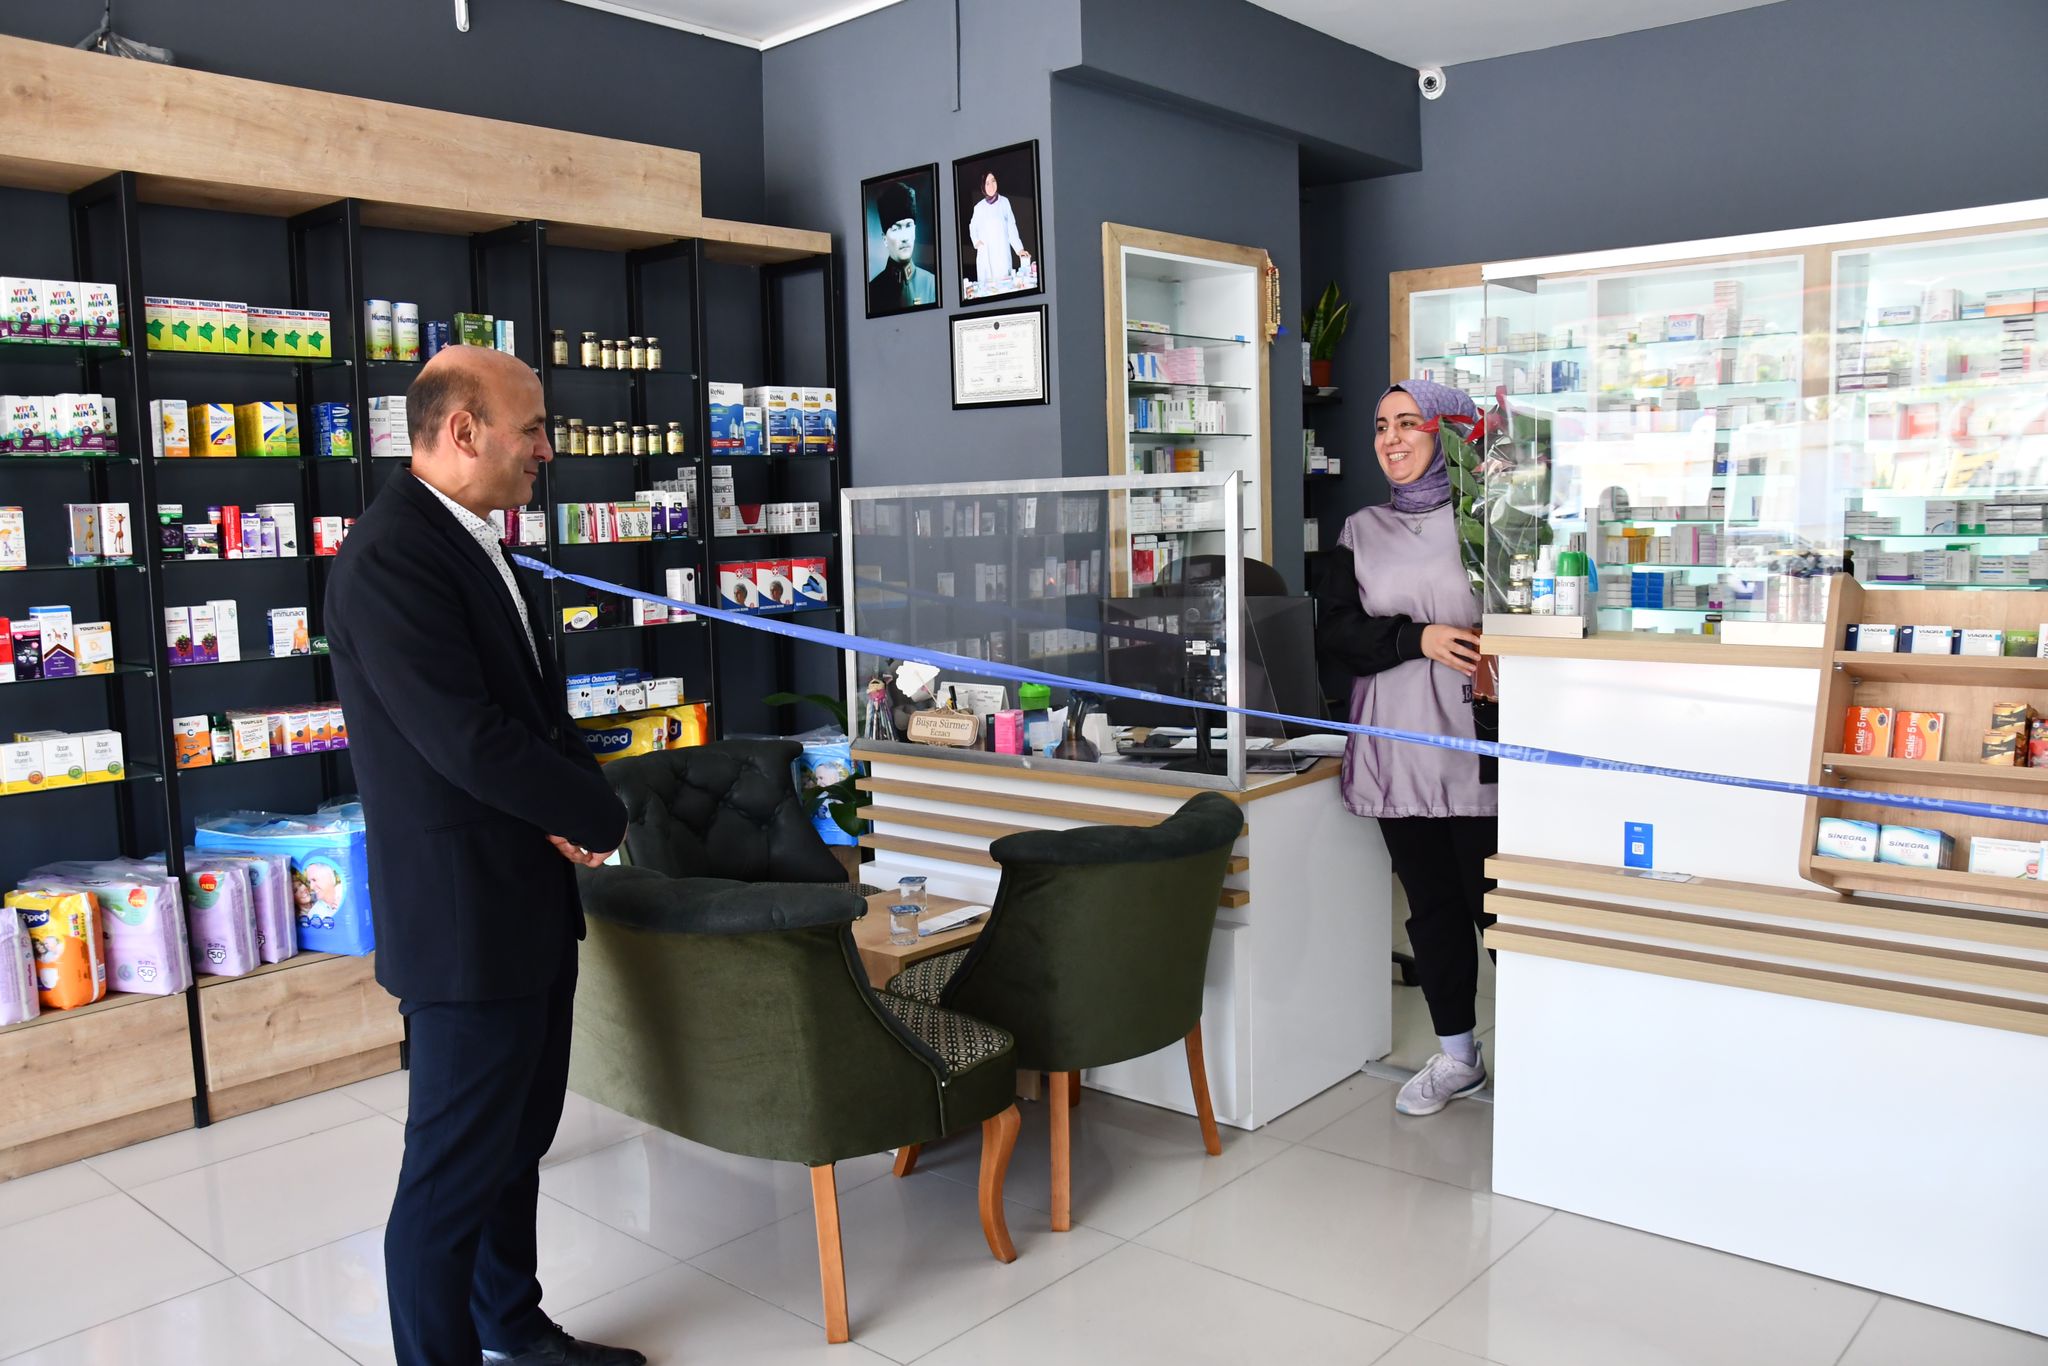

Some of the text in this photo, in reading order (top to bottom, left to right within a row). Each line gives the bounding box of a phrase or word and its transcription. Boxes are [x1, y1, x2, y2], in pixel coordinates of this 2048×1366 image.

[591, 675, 616, 683] Osteocare
[618, 687, 640, 696] artego
[915, 716, 970, 730] Büşra Sürmez
[929, 728, 951, 737] Eczacı
